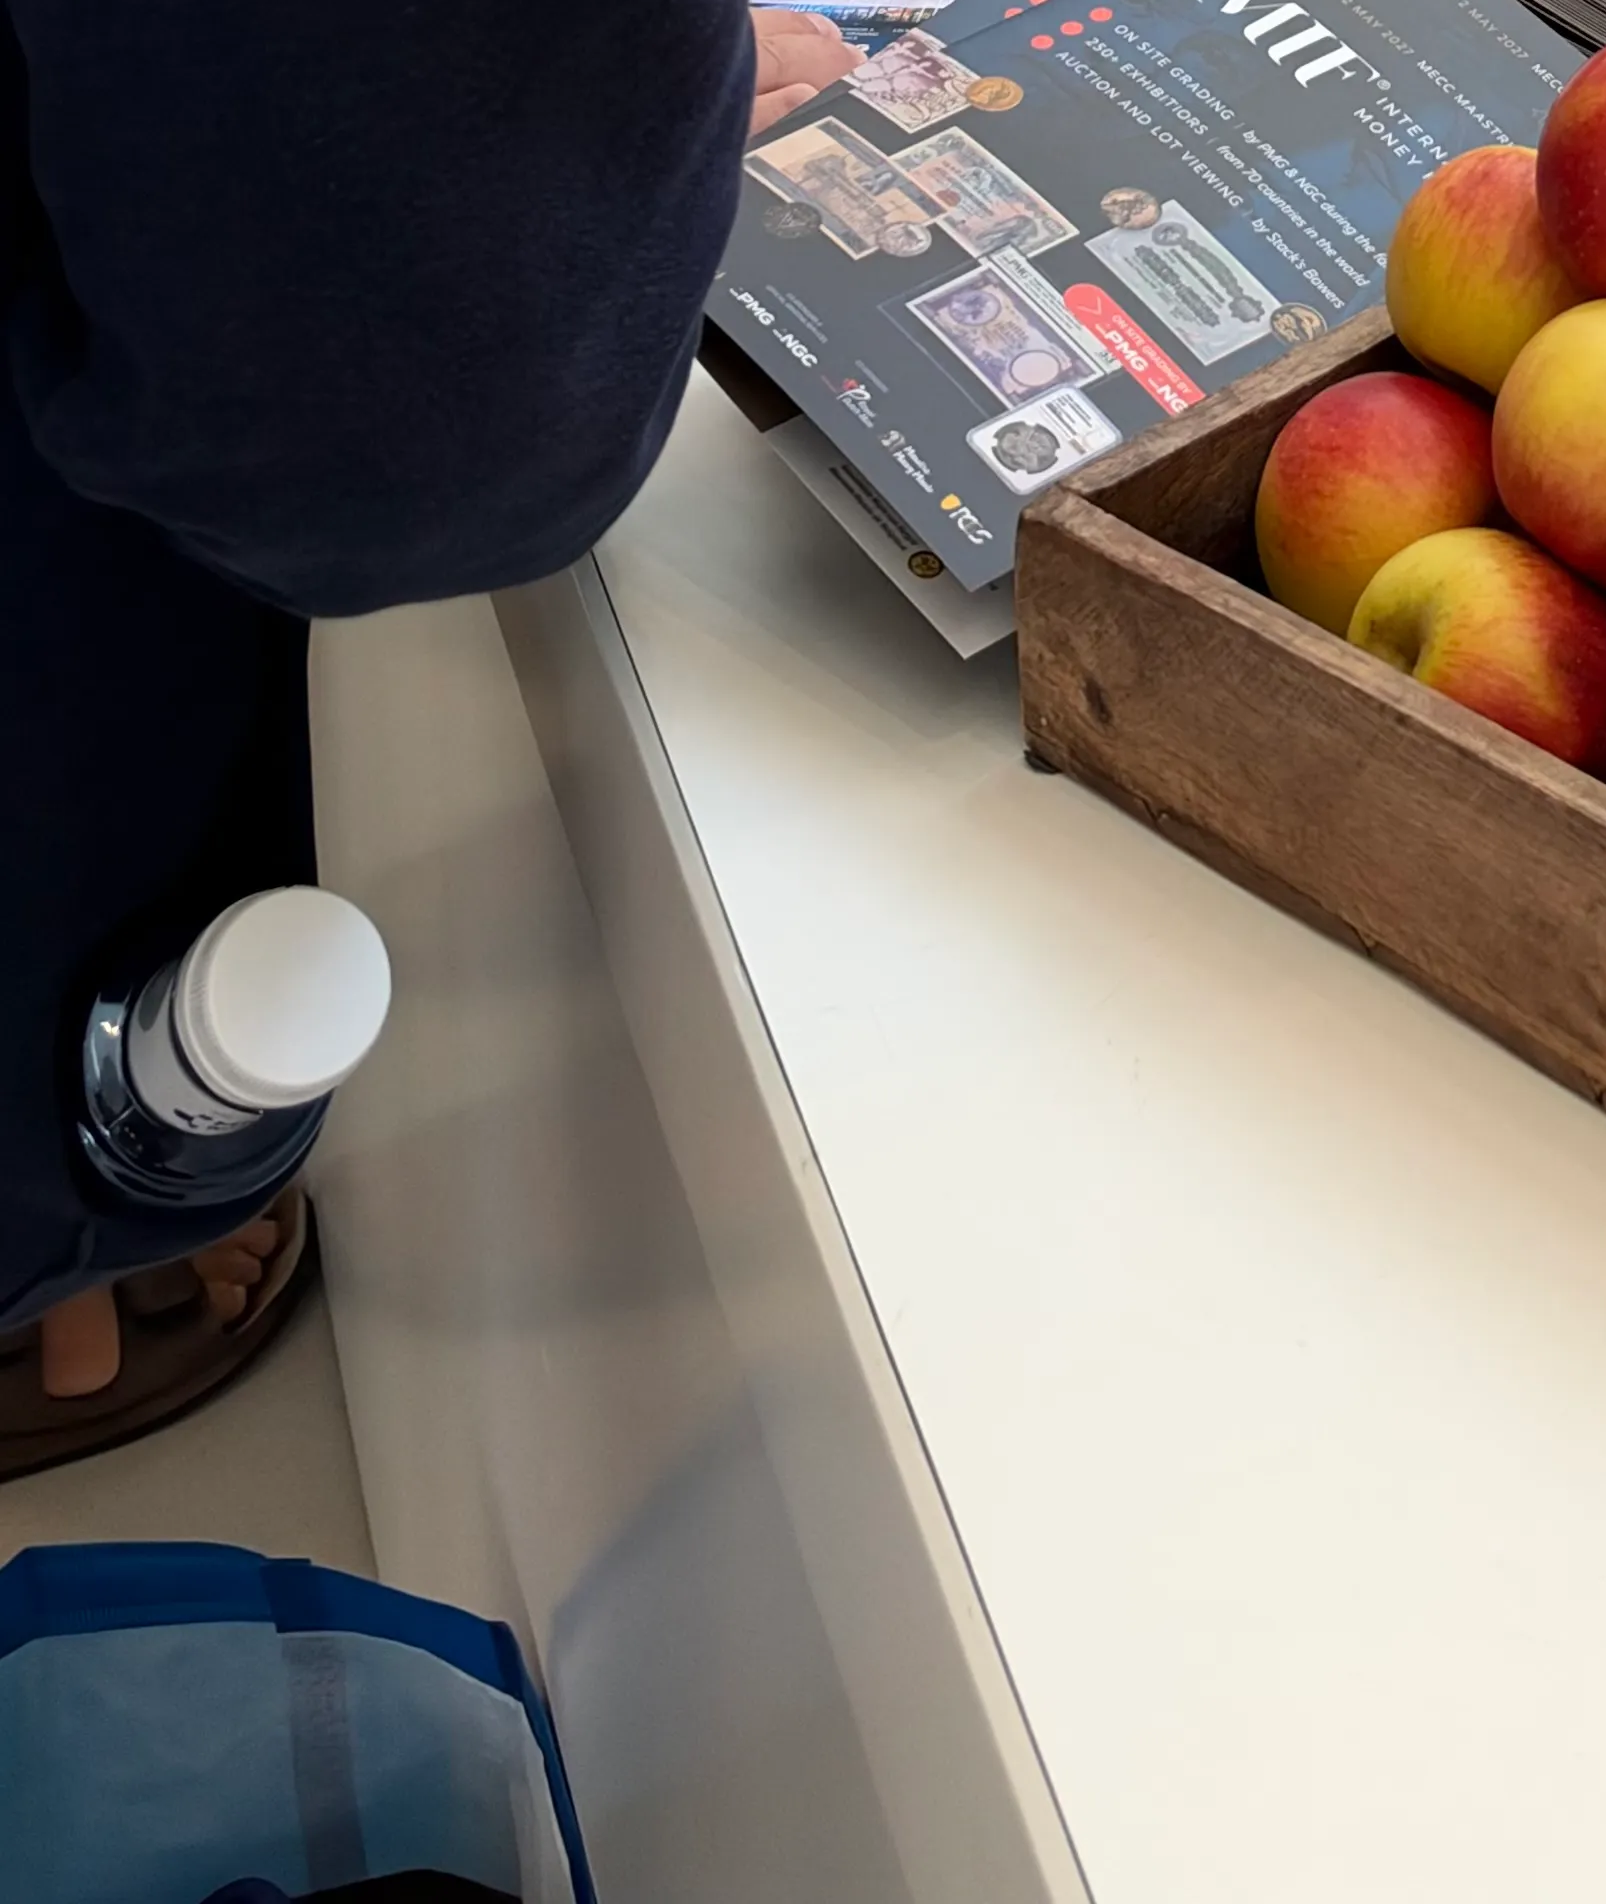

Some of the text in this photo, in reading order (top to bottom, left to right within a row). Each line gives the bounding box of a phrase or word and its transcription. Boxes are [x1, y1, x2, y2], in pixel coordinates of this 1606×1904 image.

[1352, 4, 1384, 29] MAY
[1381, 30, 1416, 56] 2027
[1416, 58, 1457, 94] MECC
[1468, 8, 1501, 33] MAY
[1496, 32, 1530, 61] 2027
[1084, 36, 1120, 63] 250+
[1216, 144, 1246, 171] from
[1242, 167, 1263, 184] 70
[1256, 182, 1309, 230] countries
[1303, 225, 1319, 240] in
[1315, 237, 1338, 259] the
[1334, 255, 1371, 288] world
[1113, 24, 1141, 44] ON
[1136, 41, 1172, 68] SITE
[1169, 66, 1236, 122] GRADING
[1257, 142, 1291, 170] PMG
[1294, 176, 1327, 205] NGC
[1319, 201, 1357, 238] during
[1354, 233, 1377, 255] the
[1353, 106, 1424, 167] MONEY
[1375, 96, 1450, 167] INTERN
[1055, 50, 1346, 311] AUCTION AND LOT VIEWING by Stack's Bowers
[736, 290, 777, 327] PMG
[778, 333, 819, 368] NGC
[1103, 329, 1150, 373] PMG
[1155, 383, 1190, 414] NG
